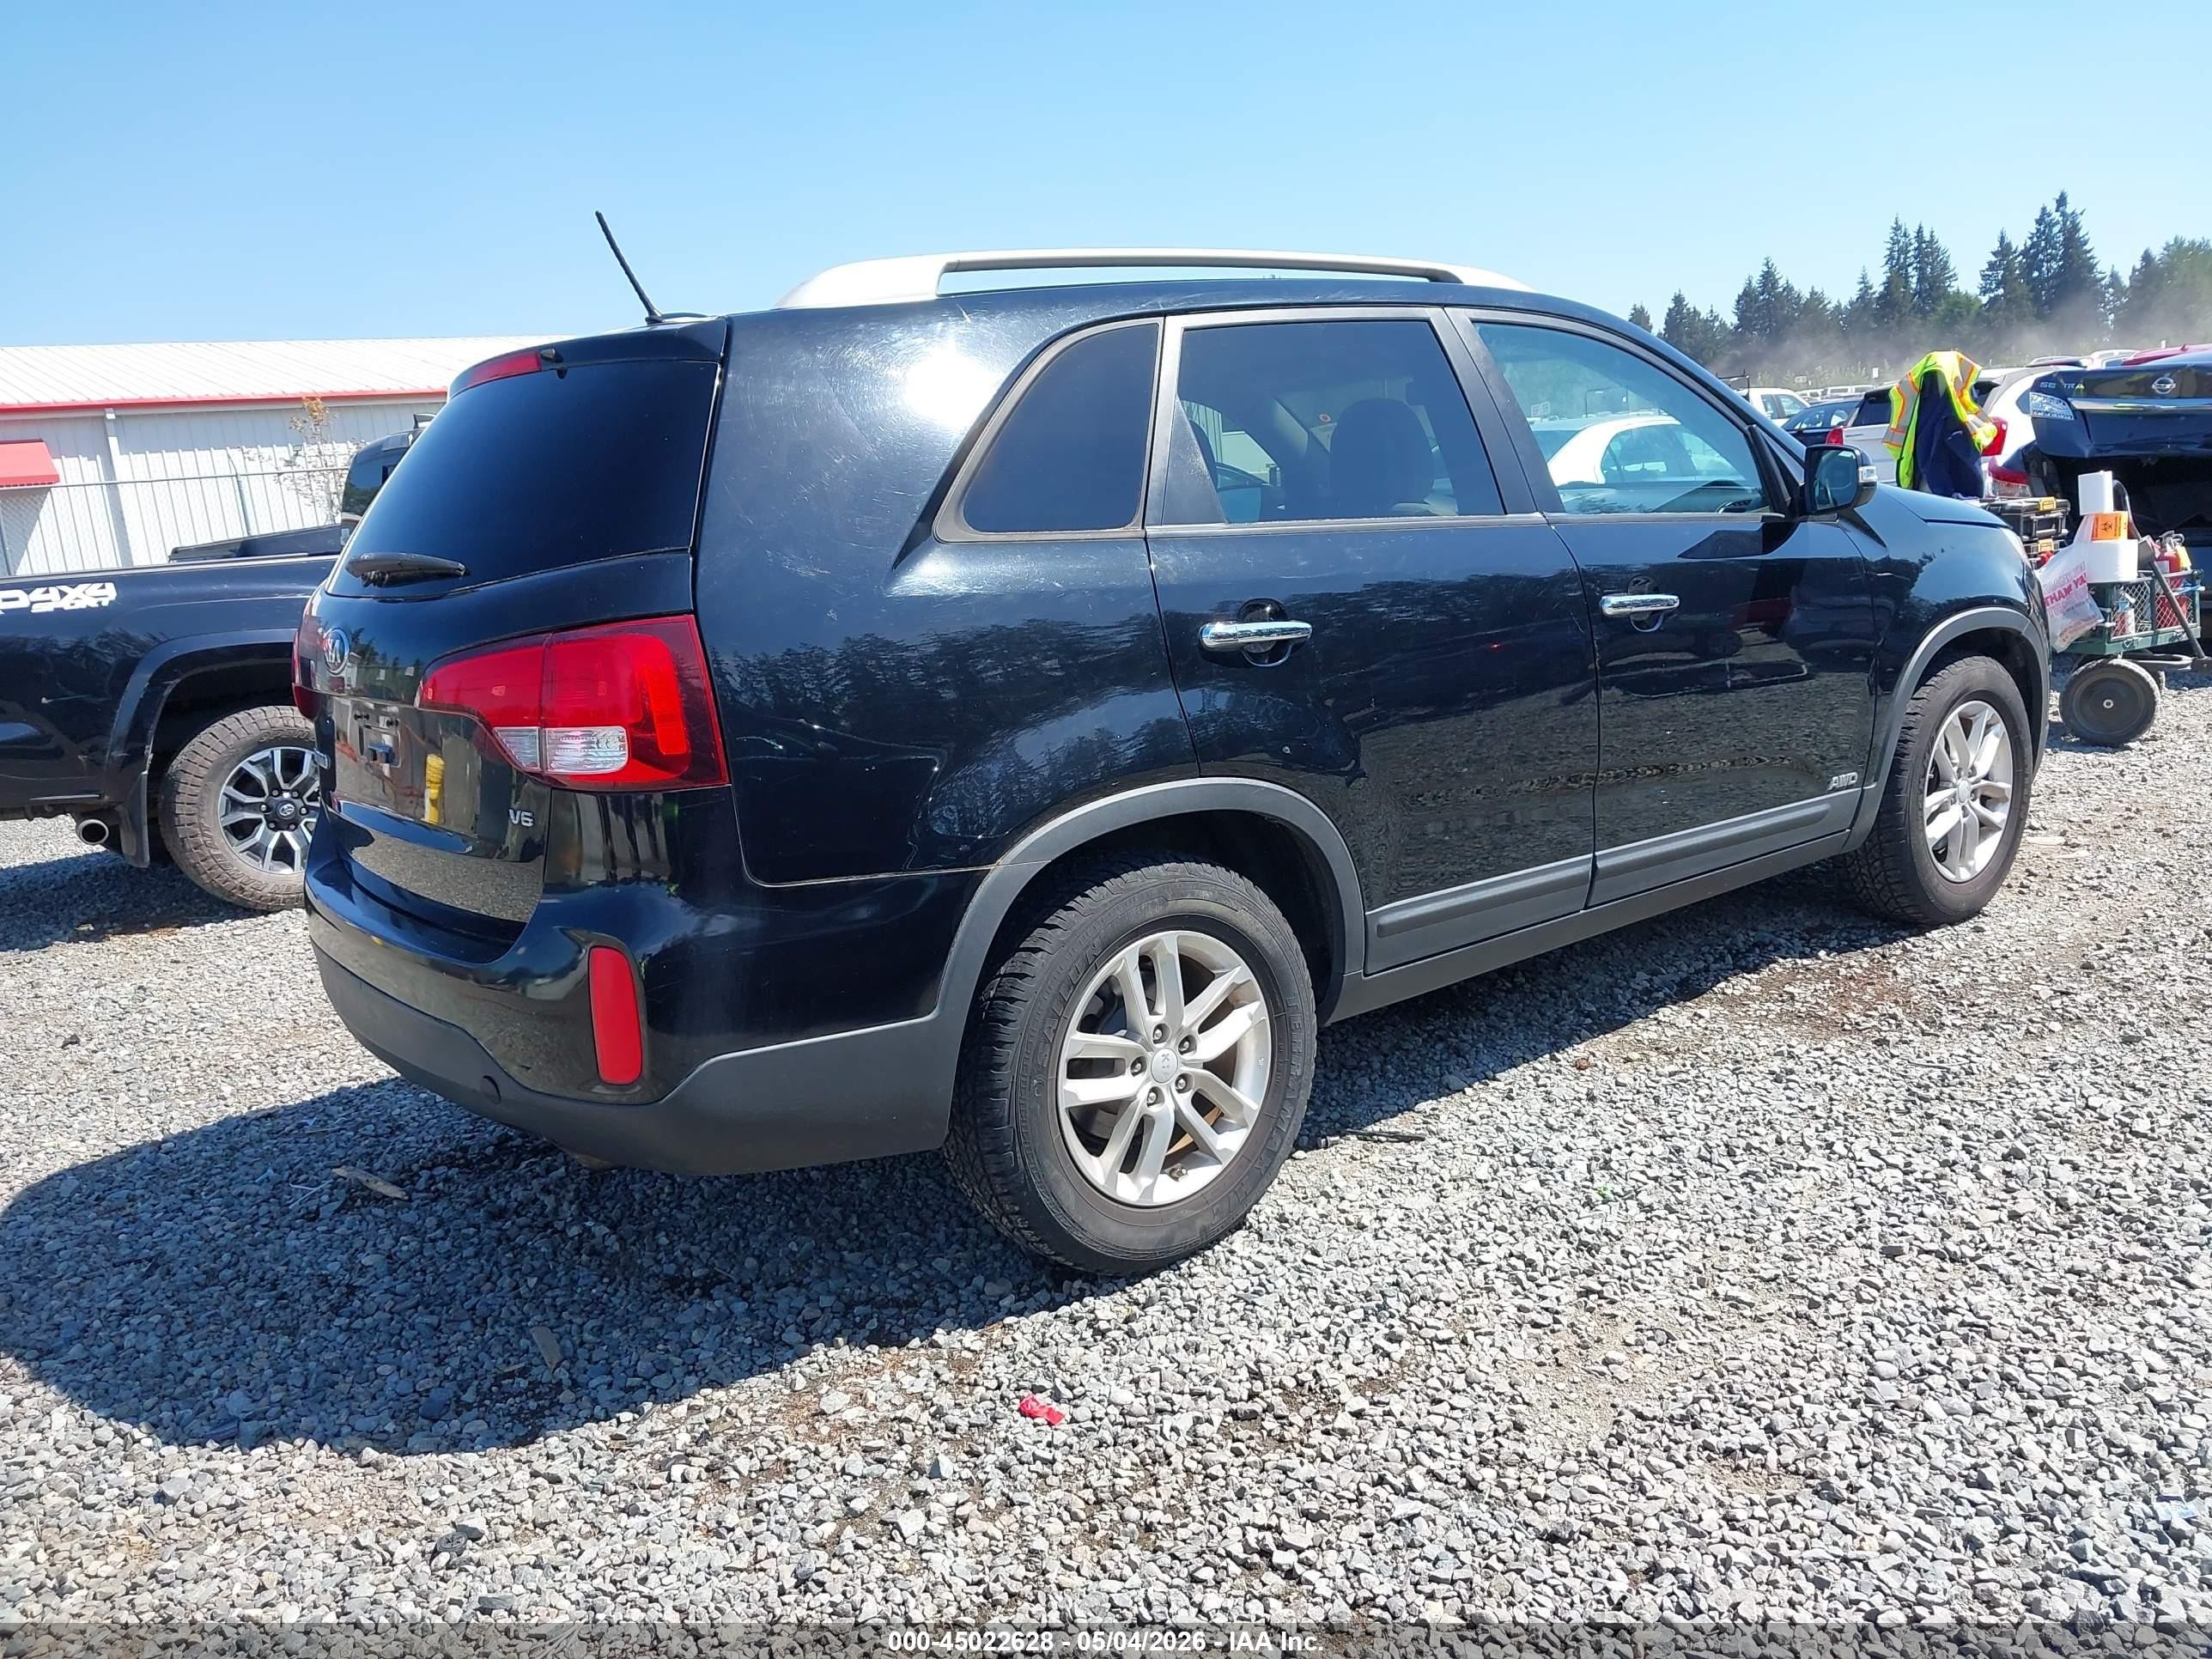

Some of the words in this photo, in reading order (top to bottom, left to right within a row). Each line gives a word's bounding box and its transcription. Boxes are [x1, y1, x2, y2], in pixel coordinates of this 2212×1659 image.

[31, 599, 110, 613] SPORT
[1828, 772, 1858, 790] AWD
[508, 809, 534, 827] V6
